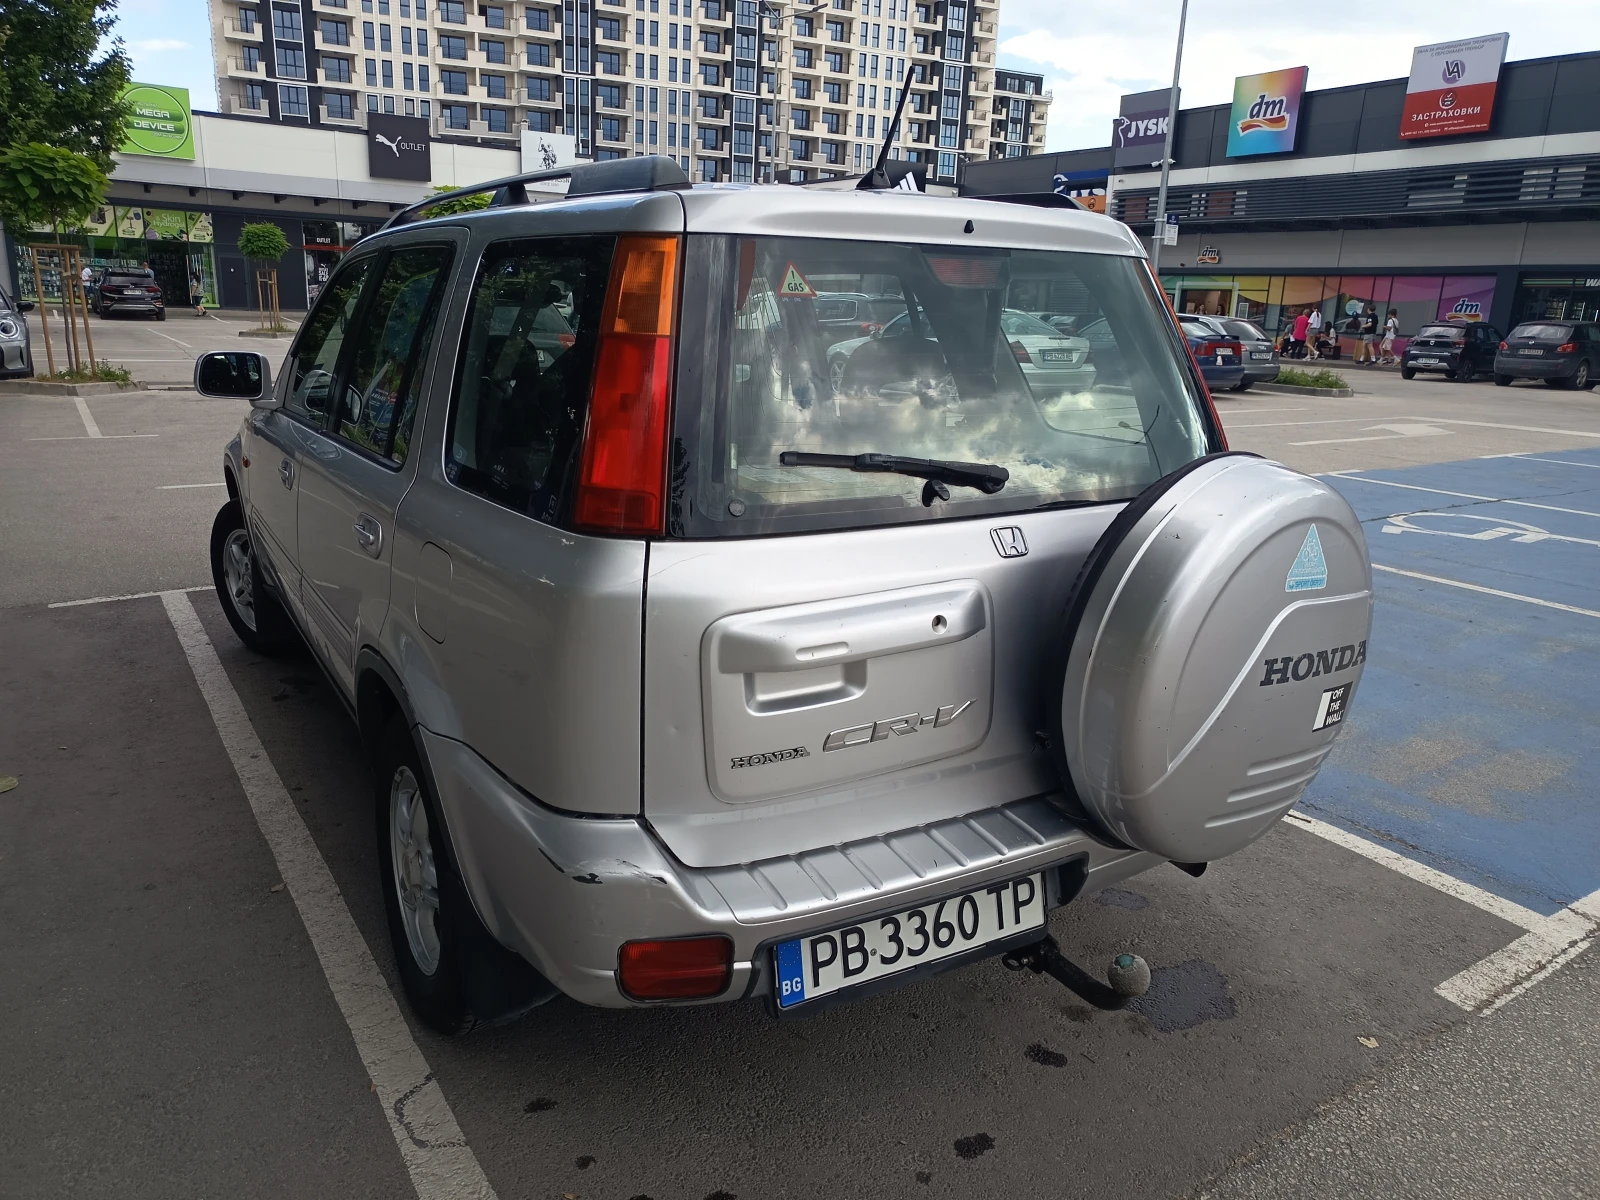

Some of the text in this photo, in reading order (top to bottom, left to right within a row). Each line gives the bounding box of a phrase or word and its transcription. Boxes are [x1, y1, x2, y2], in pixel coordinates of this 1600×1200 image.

[136, 107, 170, 119] MEGA
[1248, 94, 1285, 120] dm
[1411, 106, 1481, 122] ЗАСТРАХОВКИ
[133, 120, 175, 132] DEVICE
[1127, 116, 1169, 139] JYSK
[400, 142, 426, 152] OUTLET
[161, 213, 181, 223] Skin
[1202, 246, 1217, 258] dm
[787, 282, 804, 292] GAS
[1454, 299, 1480, 314] dm
[1259, 639, 1367, 687] HONDA
[1329, 700, 1341, 713] THE
[822, 698, 978, 753] CR-V
[731, 746, 810, 769] HONDA
[809, 876, 1036, 989] PB 3360 TP
[781, 976, 803, 996] BG
